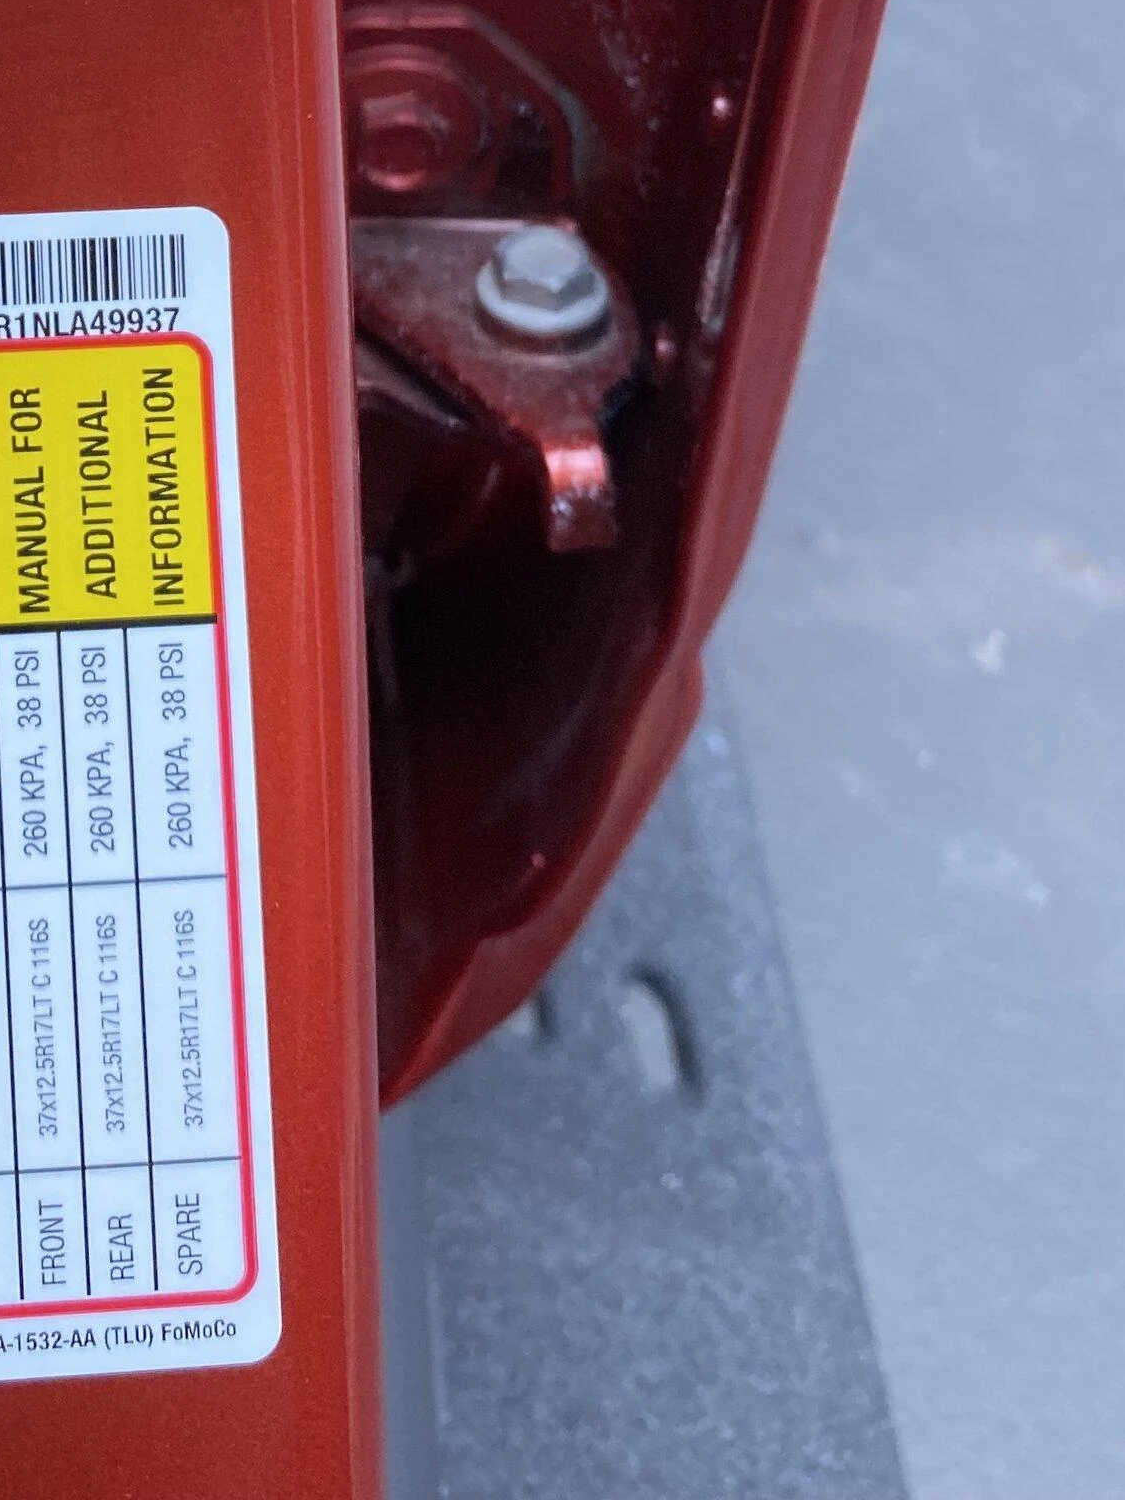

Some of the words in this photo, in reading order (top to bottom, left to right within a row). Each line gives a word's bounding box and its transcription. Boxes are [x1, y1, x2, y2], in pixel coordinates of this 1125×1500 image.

[9, 386, 44, 453] FOR
[76, 389, 118, 599] ADDITIONAL
[141, 367, 185, 606] INFORMATION
[13, 465, 51, 614] MANUAL
[14, 649, 41, 688] PSI
[16, 696, 42, 729] 38
[19, 745, 48, 801] KPA,
[21, 809, 48, 856] 260
[28, 918, 50, 968] 116S
[31, 974, 52, 988] C
[32, 994, 58, 1137] 37x12.5R17LT
[37, 1199, 67, 1286] FRONT
[107, 1213, 135, 1281] REAR
[175, 1192, 203, 1276] SPARE
[104, 1324, 155, 1351] (TLU)
[161, 1319, 237, 1342] FoMoCo
